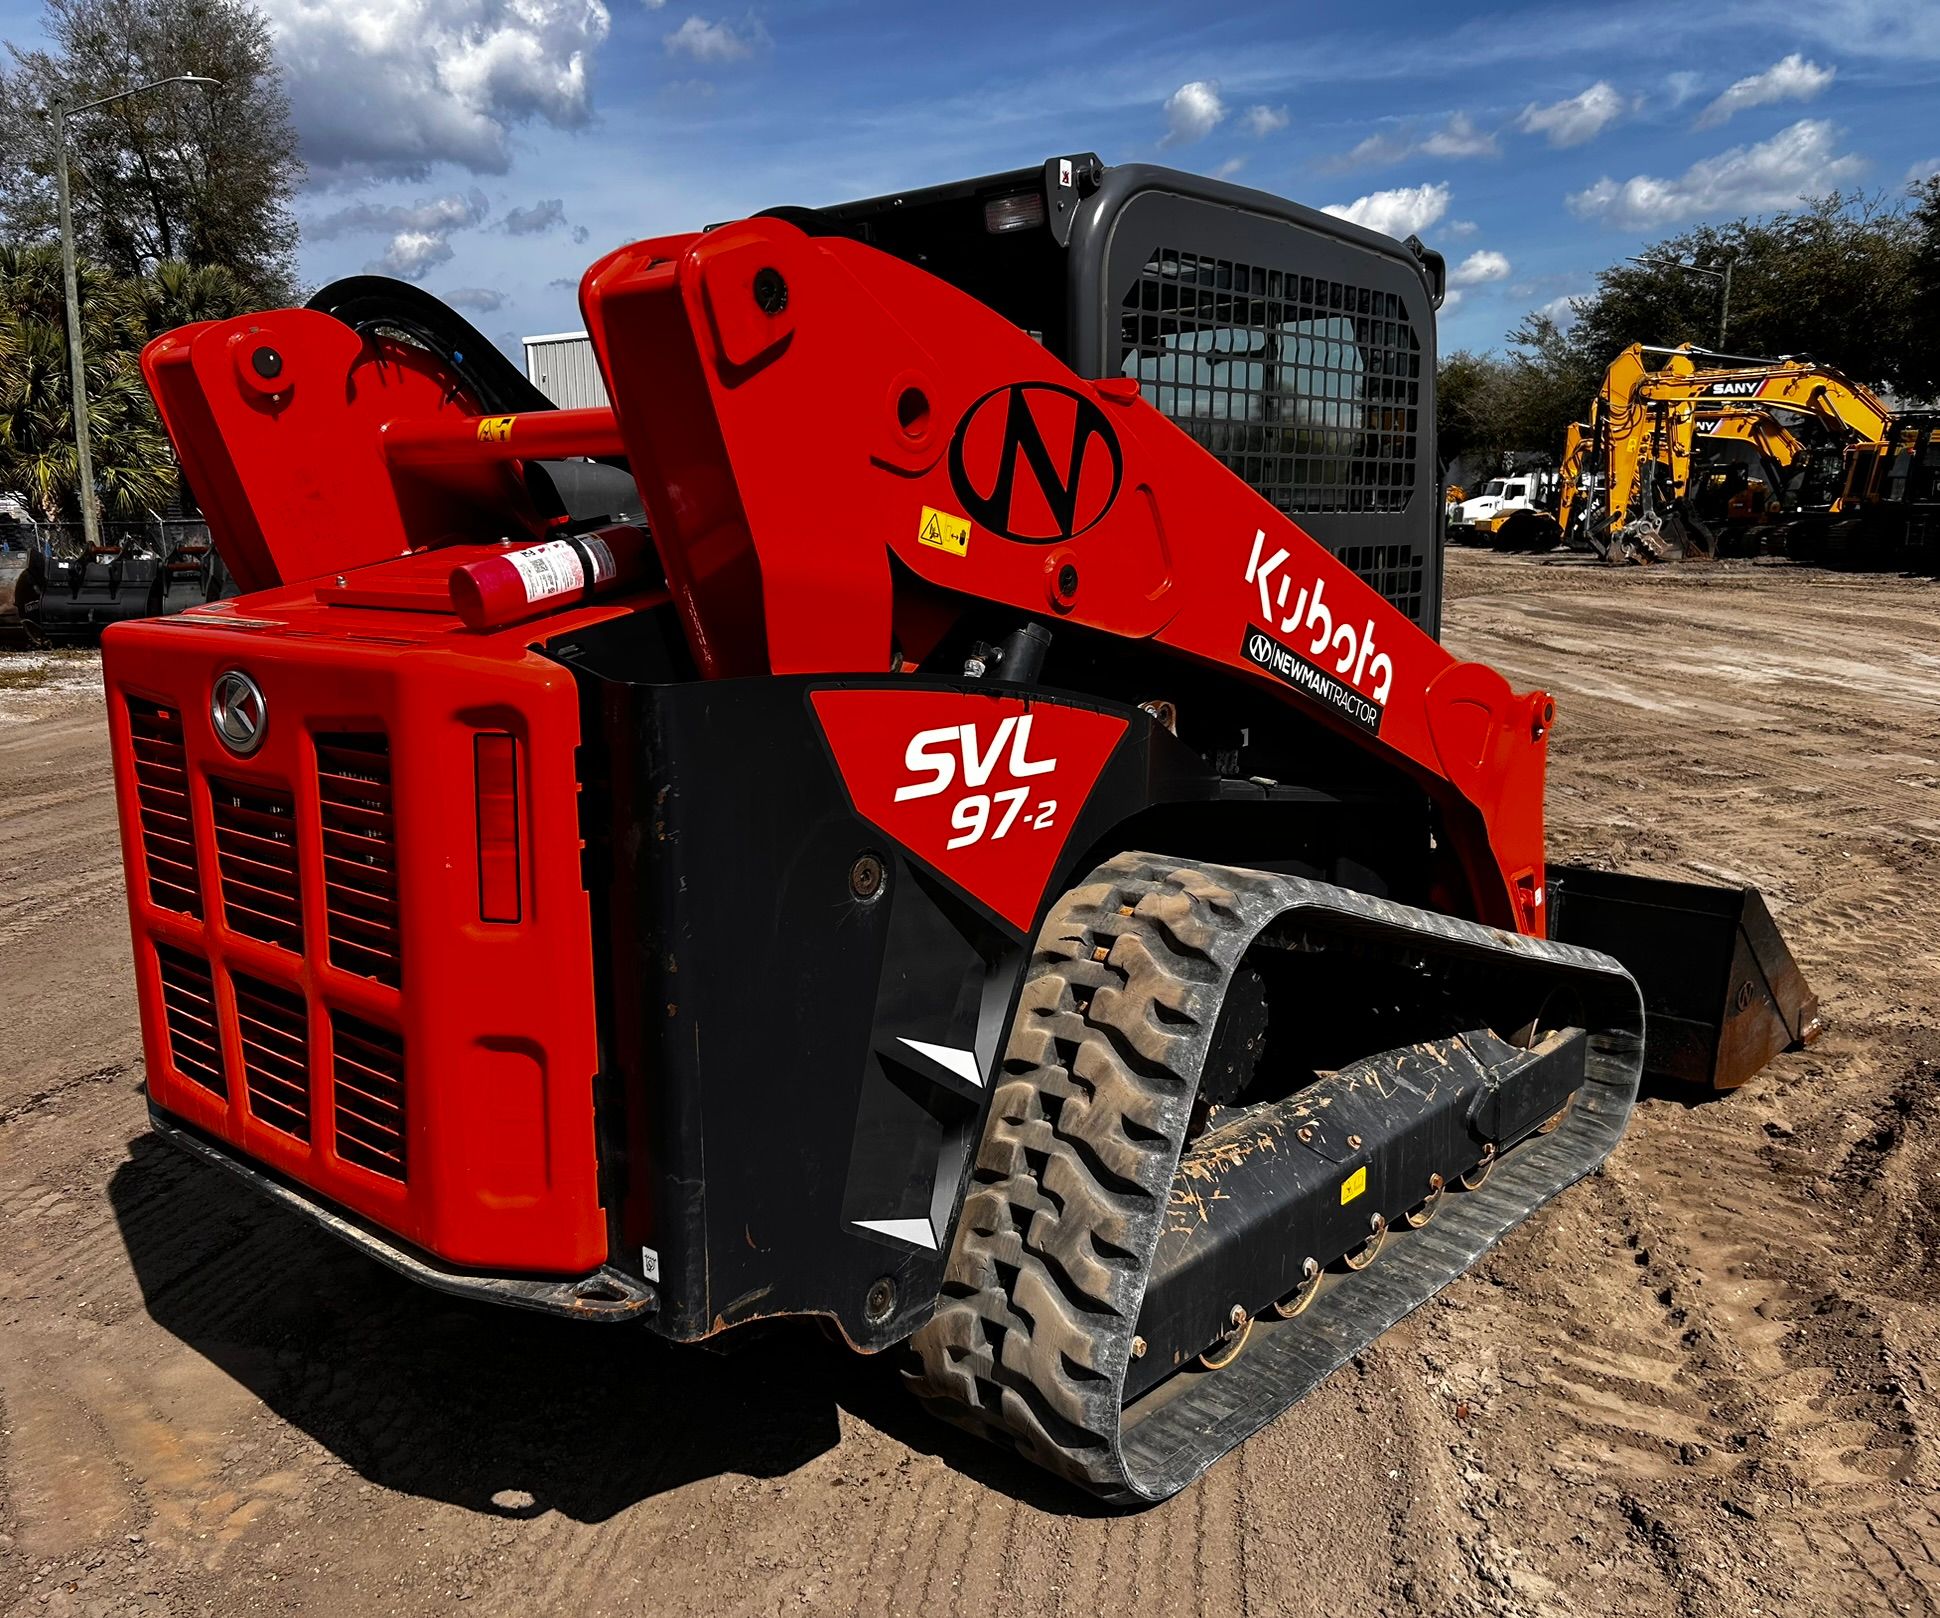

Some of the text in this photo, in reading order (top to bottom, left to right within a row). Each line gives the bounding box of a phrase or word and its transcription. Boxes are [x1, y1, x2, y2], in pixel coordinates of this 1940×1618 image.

[1712, 382, 1758, 395] SANY
[1695, 421, 1715, 431] NY
[1244, 528, 1393, 706] Kubota
[1273, 648, 1377, 727] NEWMANTRACTOR
[893, 714, 1057, 803] SVL
[946, 786, 1057, 850] 97-2
